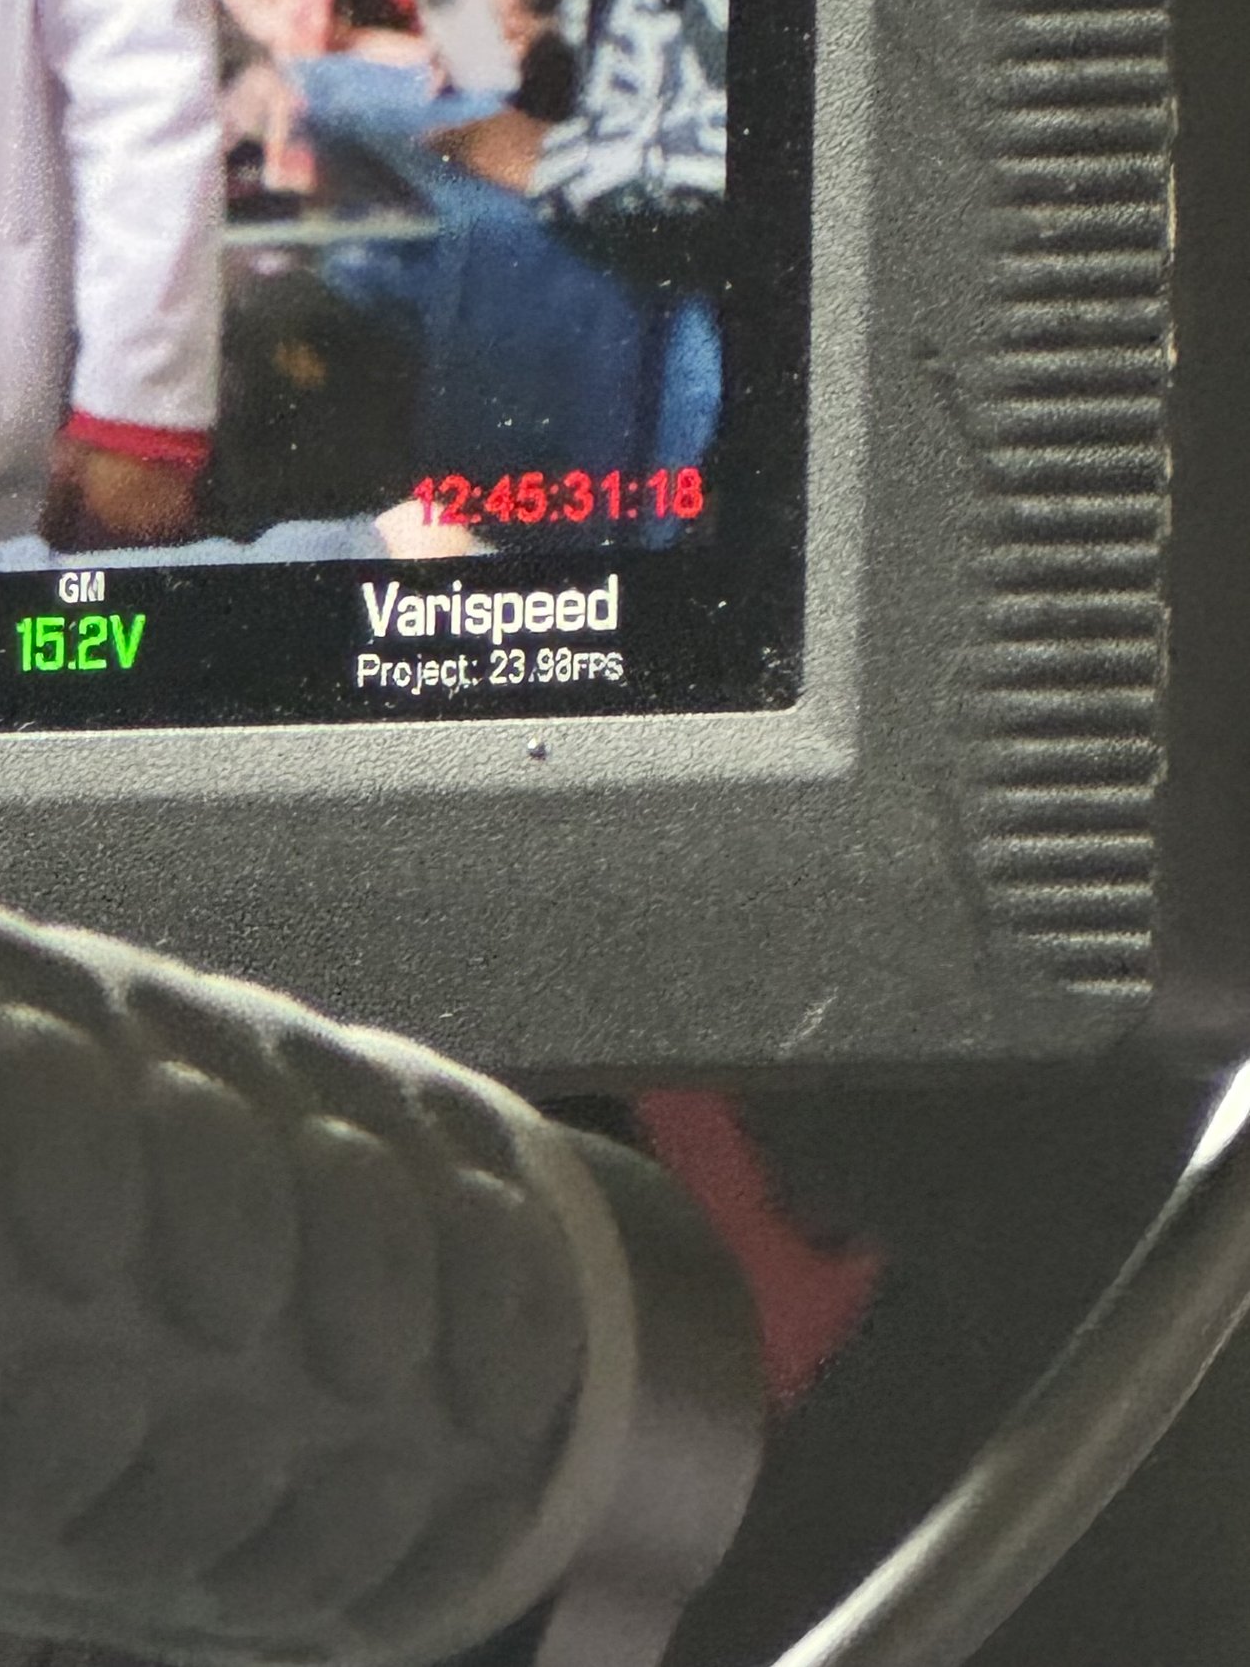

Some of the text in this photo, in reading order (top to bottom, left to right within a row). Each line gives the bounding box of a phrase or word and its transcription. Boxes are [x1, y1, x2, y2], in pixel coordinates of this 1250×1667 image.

[414, 466, 703, 525] 12:45:31:18
[361, 573, 619, 645] Varispeed
[16, 614, 146, 672] 15.2V
[356, 653, 481, 695] Project:
